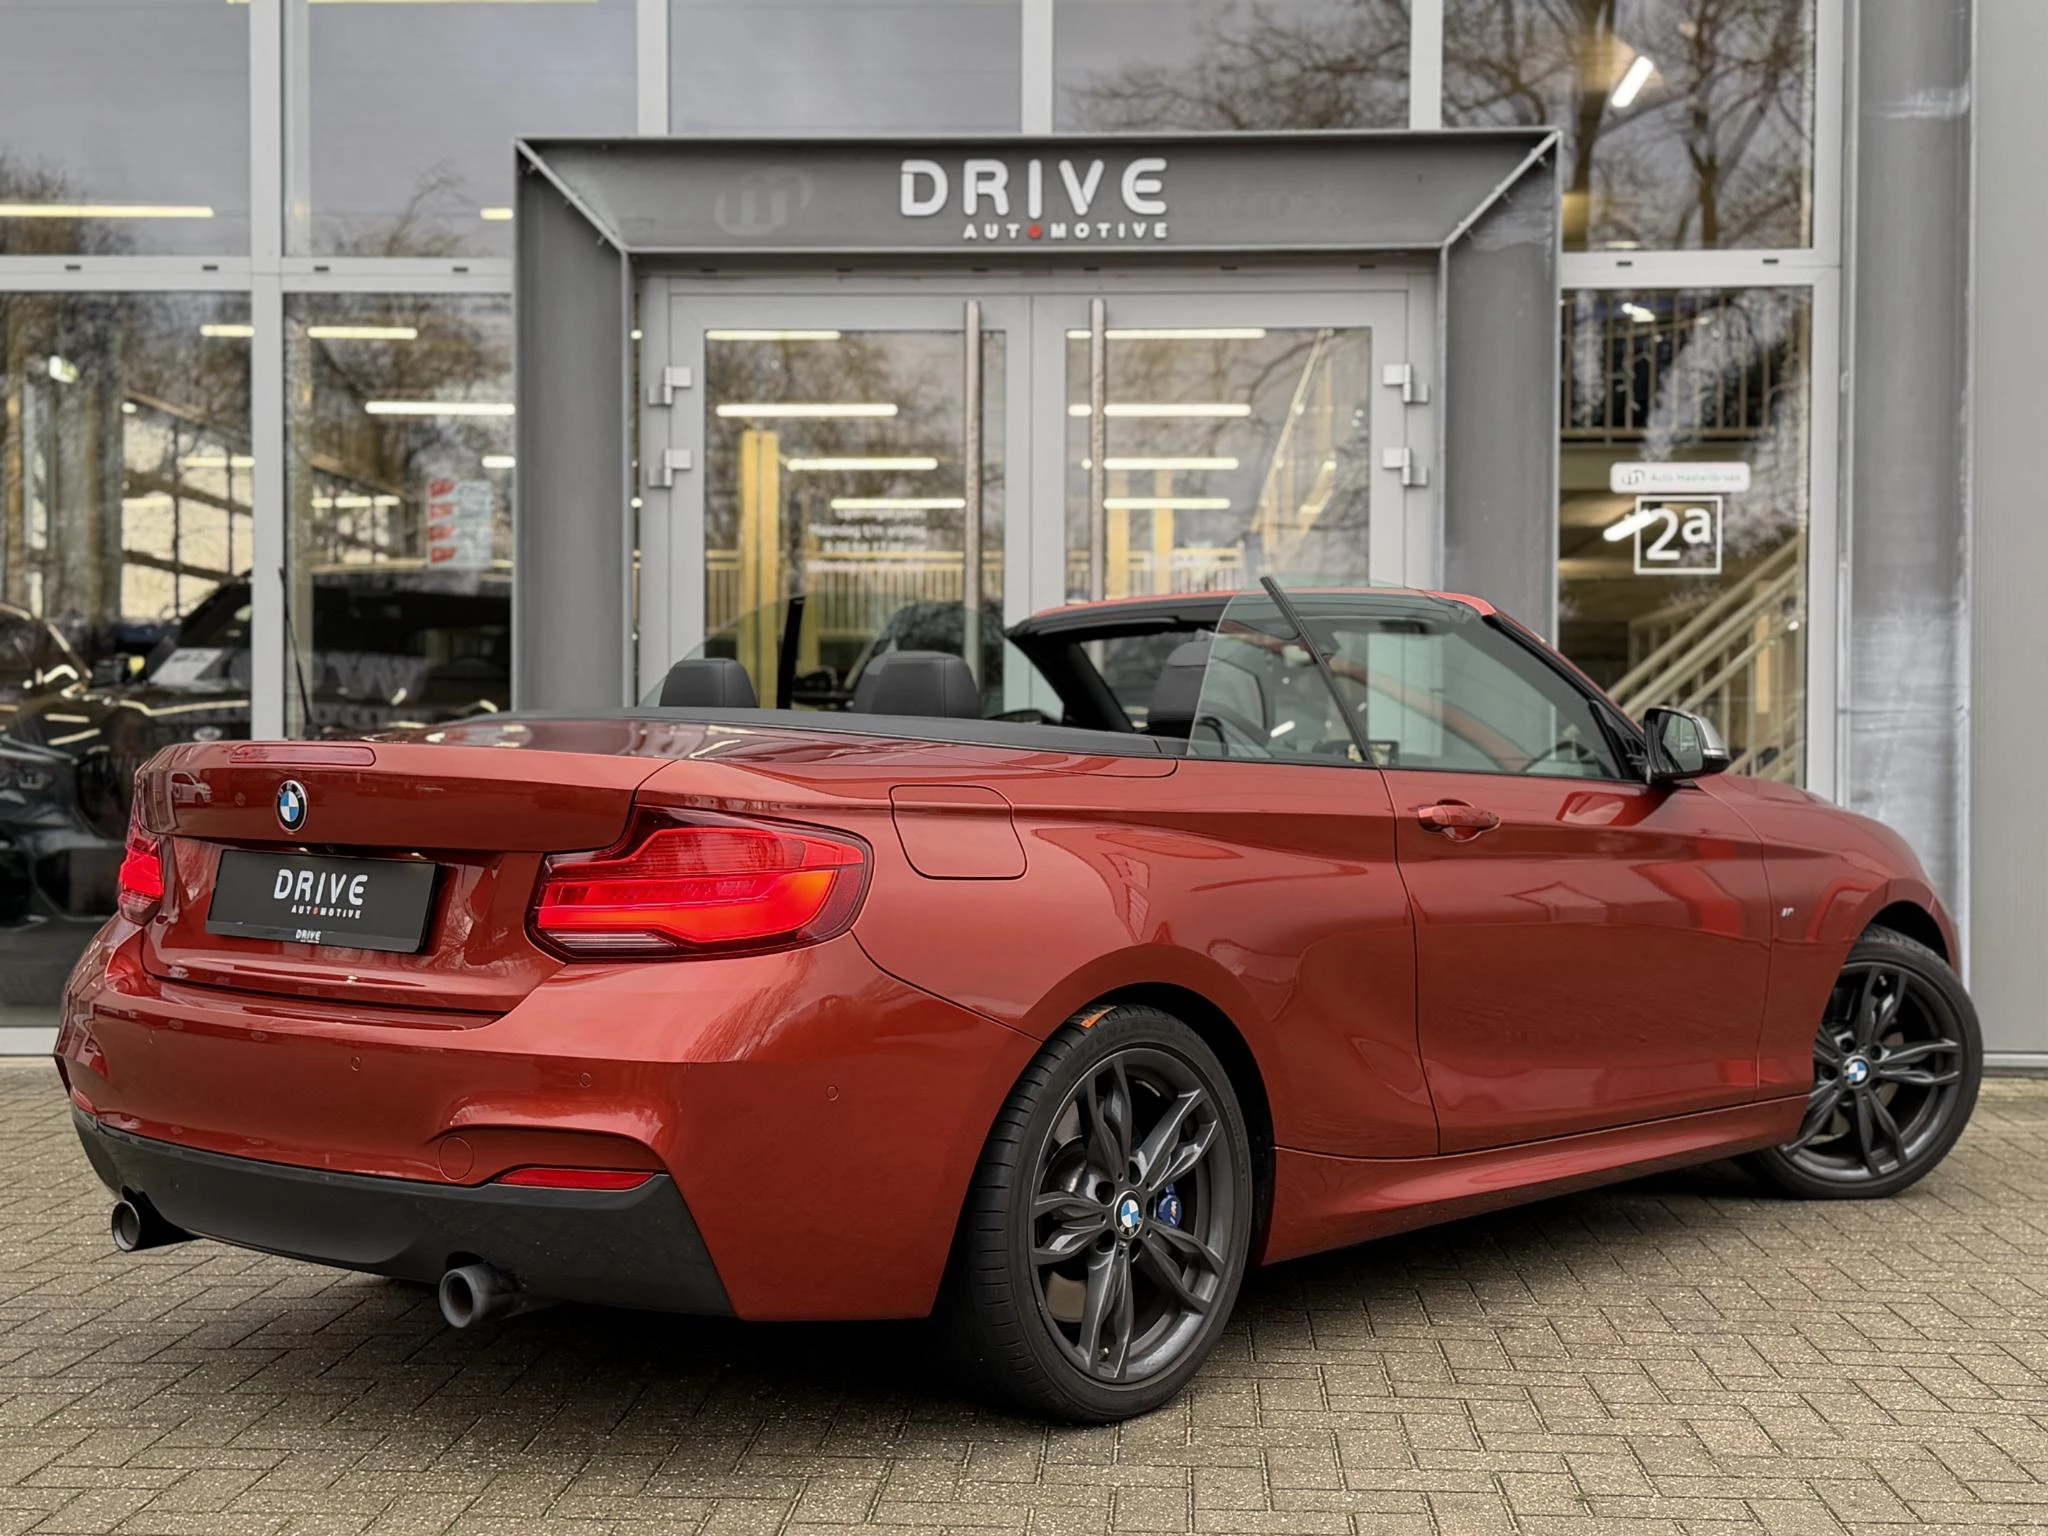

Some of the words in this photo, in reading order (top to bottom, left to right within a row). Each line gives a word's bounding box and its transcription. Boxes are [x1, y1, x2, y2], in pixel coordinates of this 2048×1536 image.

[899, 157, 1168, 220] DRIVE
[963, 222, 1168, 240] AUTOMOTIVE
[1646, 508, 1711, 560] 2a
[273, 869, 369, 906] DRIVE
[291, 904, 362, 919] AUTOMOTIVE
[295, 928, 322, 941] DRIVE
